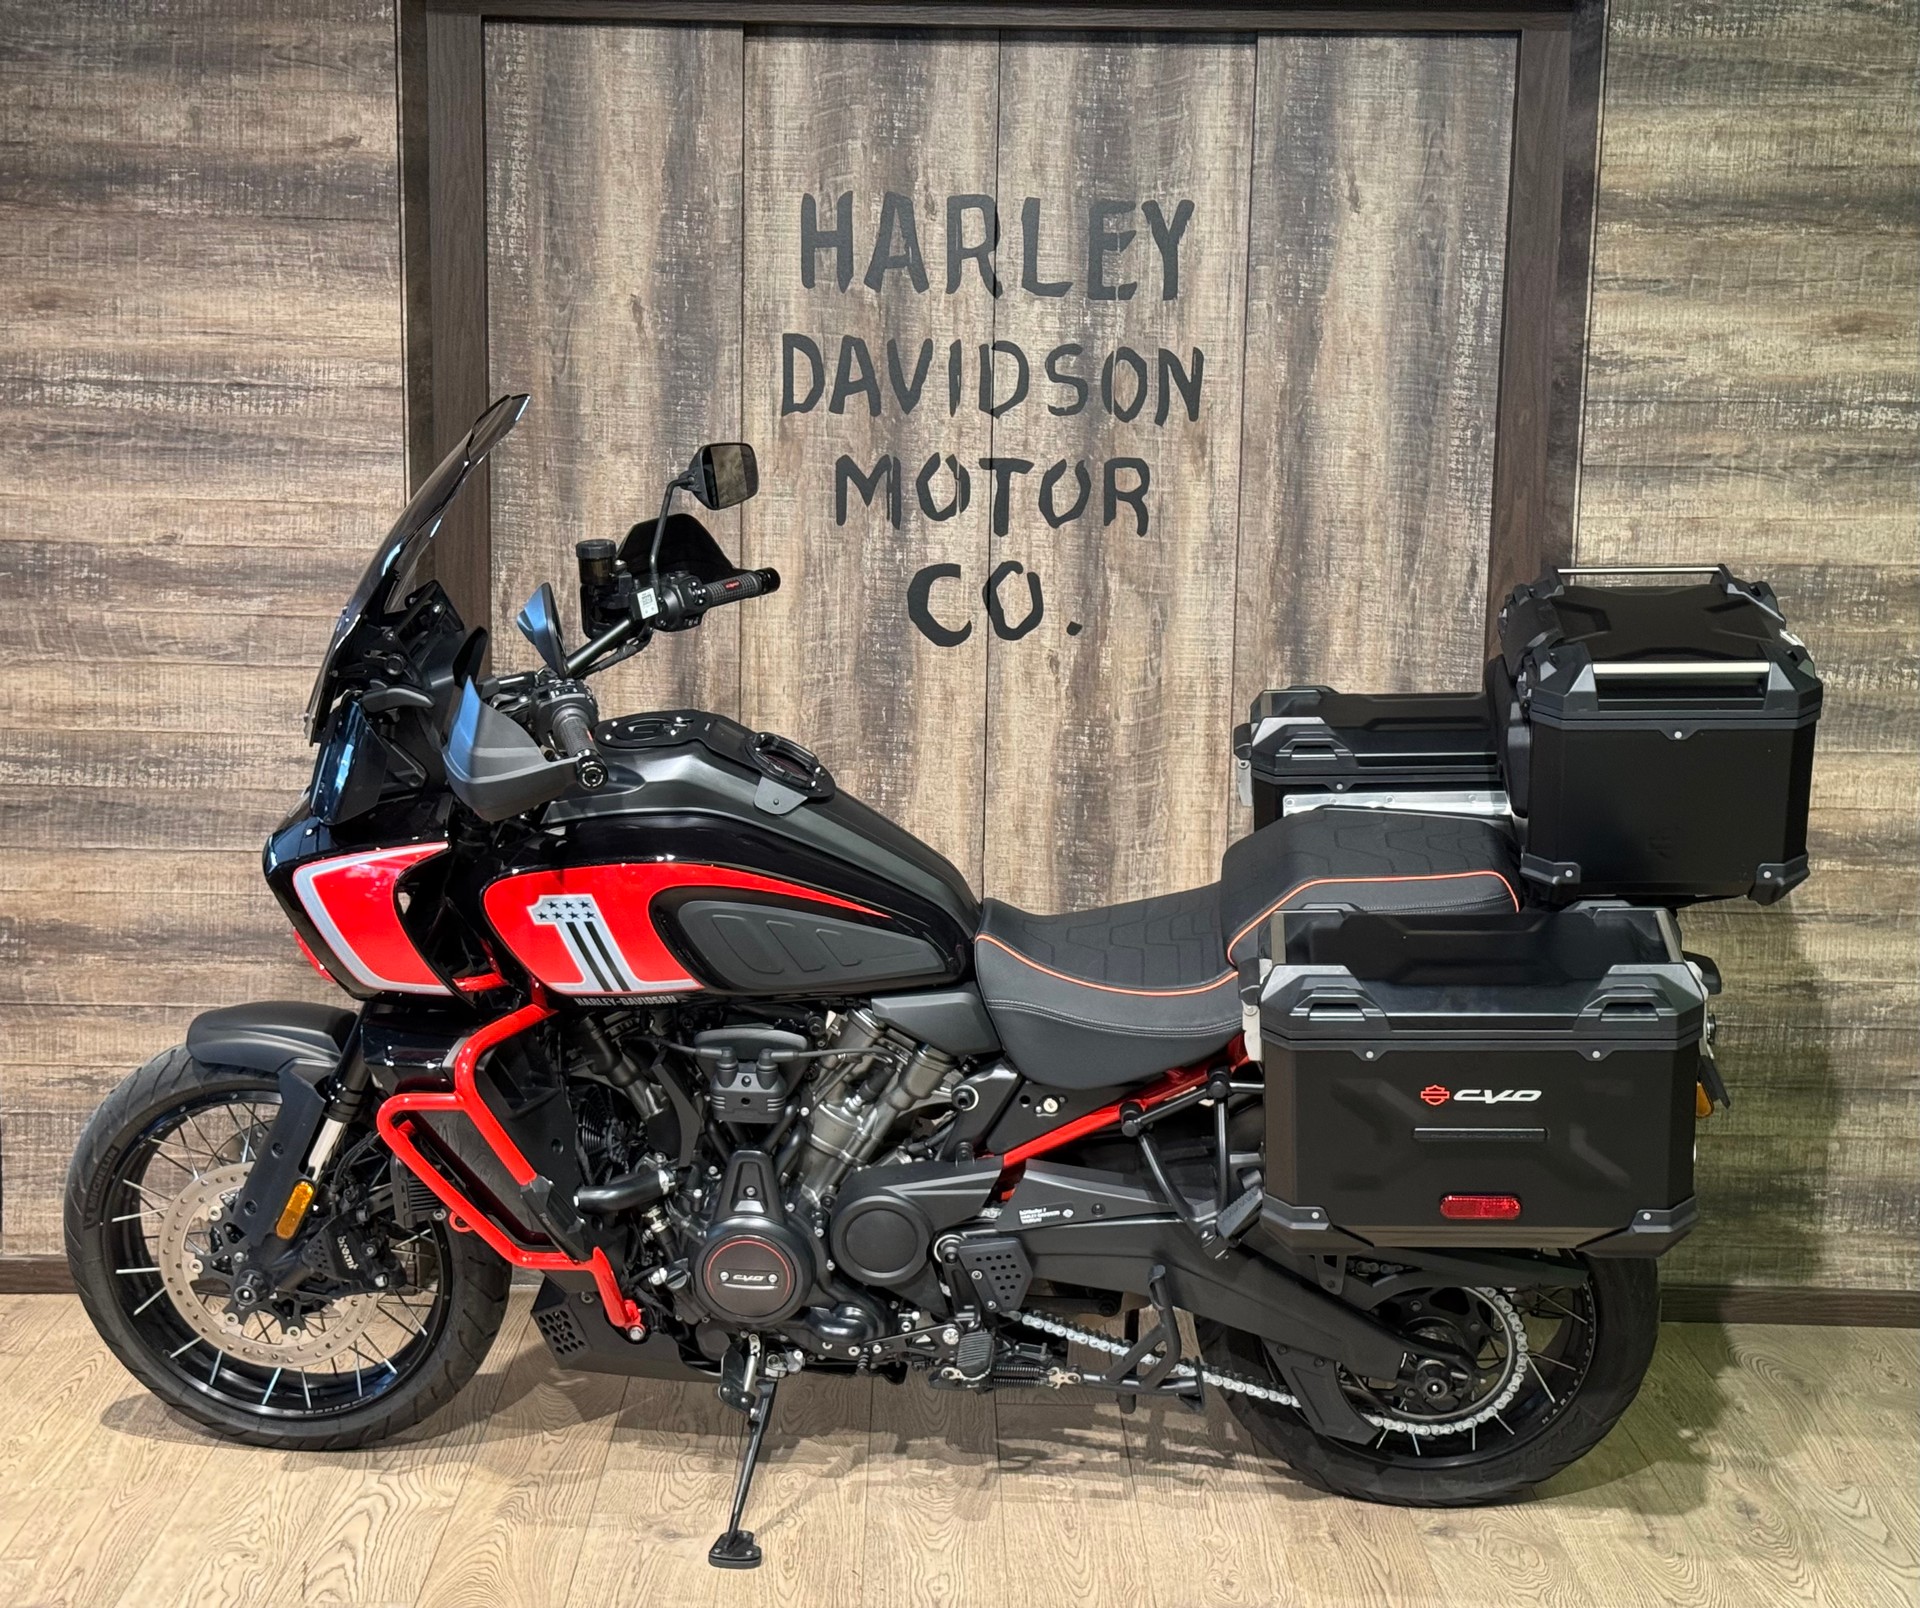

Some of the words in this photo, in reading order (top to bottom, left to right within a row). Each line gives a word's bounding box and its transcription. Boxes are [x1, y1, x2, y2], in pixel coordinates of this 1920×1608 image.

[800, 190, 1195, 300] HARLEY
[780, 332, 1205, 427] DAVIDSON
[835, 452, 1151, 538] MOTOR
[906, 560, 1083, 648] CO.
[574, 995, 678, 1006] HARLEY-DAVIDSON
[1453, 1088, 1543, 1105] CVO
[88, 1147, 118, 1209] MICHELIN
[732, 1274, 765, 1282] CVO
